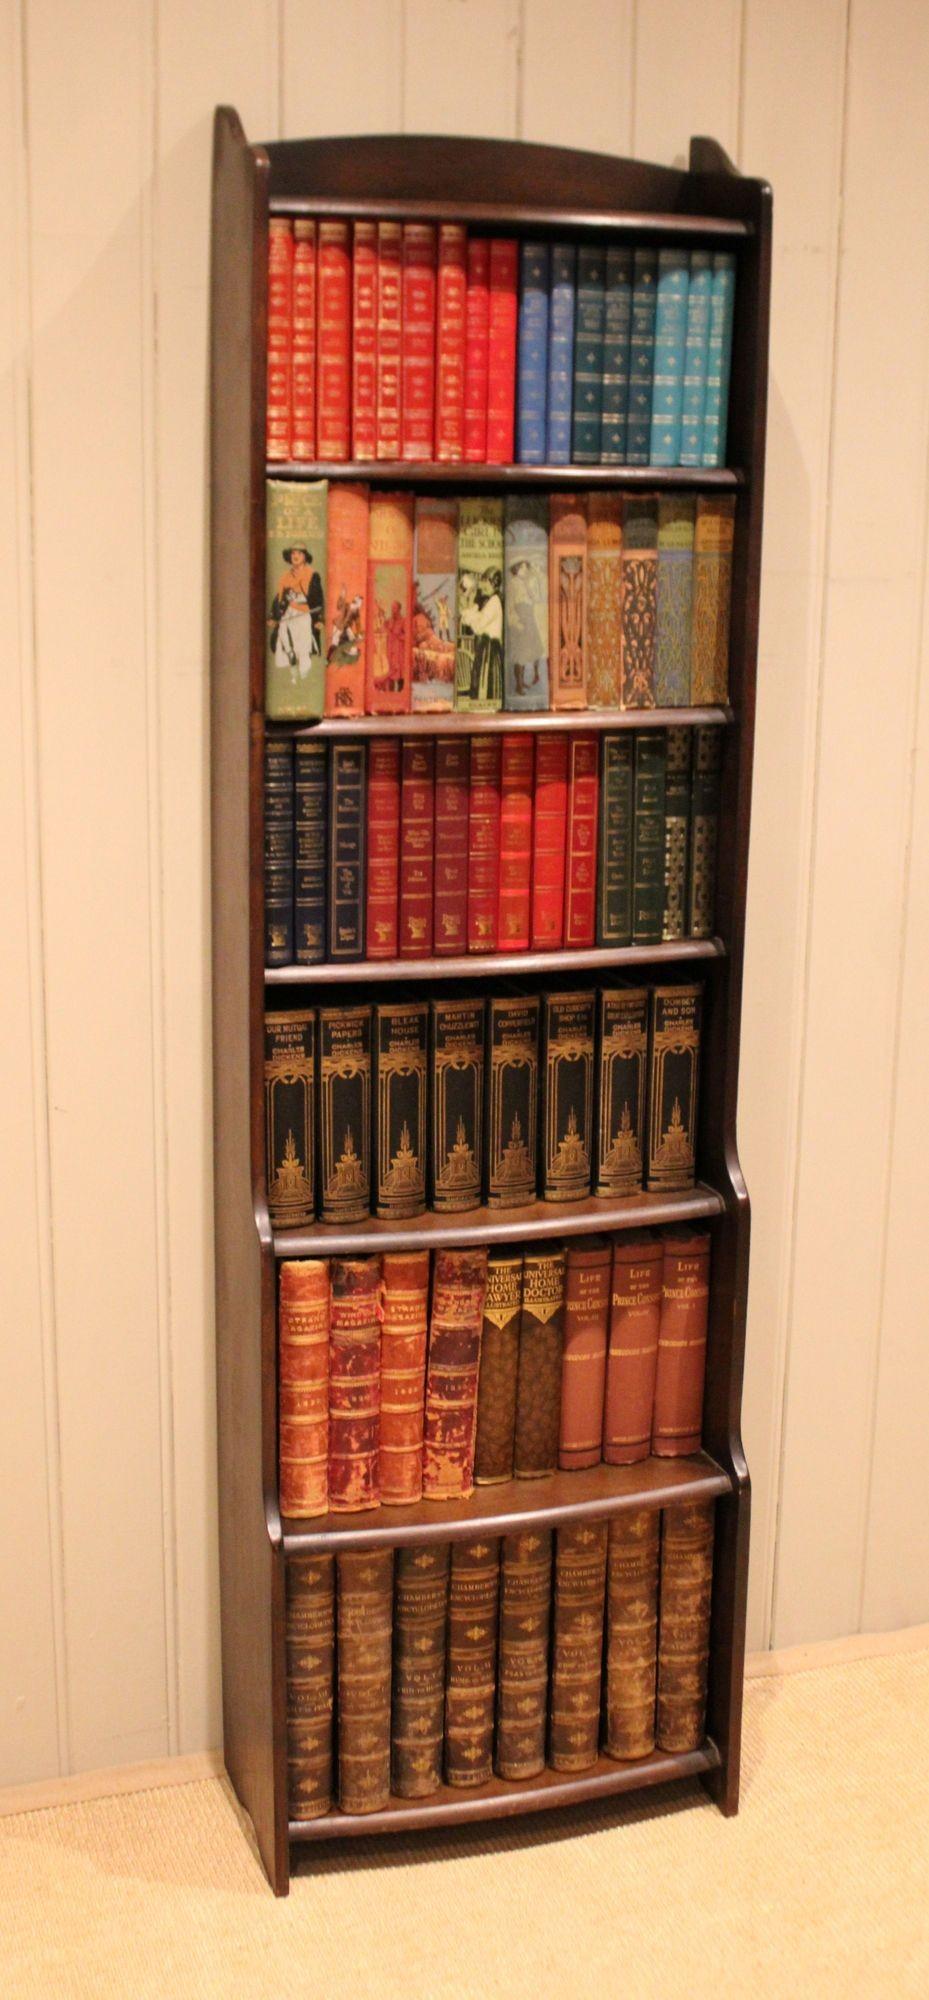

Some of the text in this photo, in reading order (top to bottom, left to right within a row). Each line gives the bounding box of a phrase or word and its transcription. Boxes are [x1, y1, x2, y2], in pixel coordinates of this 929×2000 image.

[662, 1006, 696, 1016] AND SON
[275, 1033, 303, 1042] FRIEND
[331, 1029, 363, 1039] PAPERS
[495, 1266, 512, 1275] THE
[538, 1261, 554, 1270] THE
[529, 1277, 561, 1288] HOME
[486, 1282, 517, 1294] HOME
[523, 1285, 564, 1298] DOCTOR
